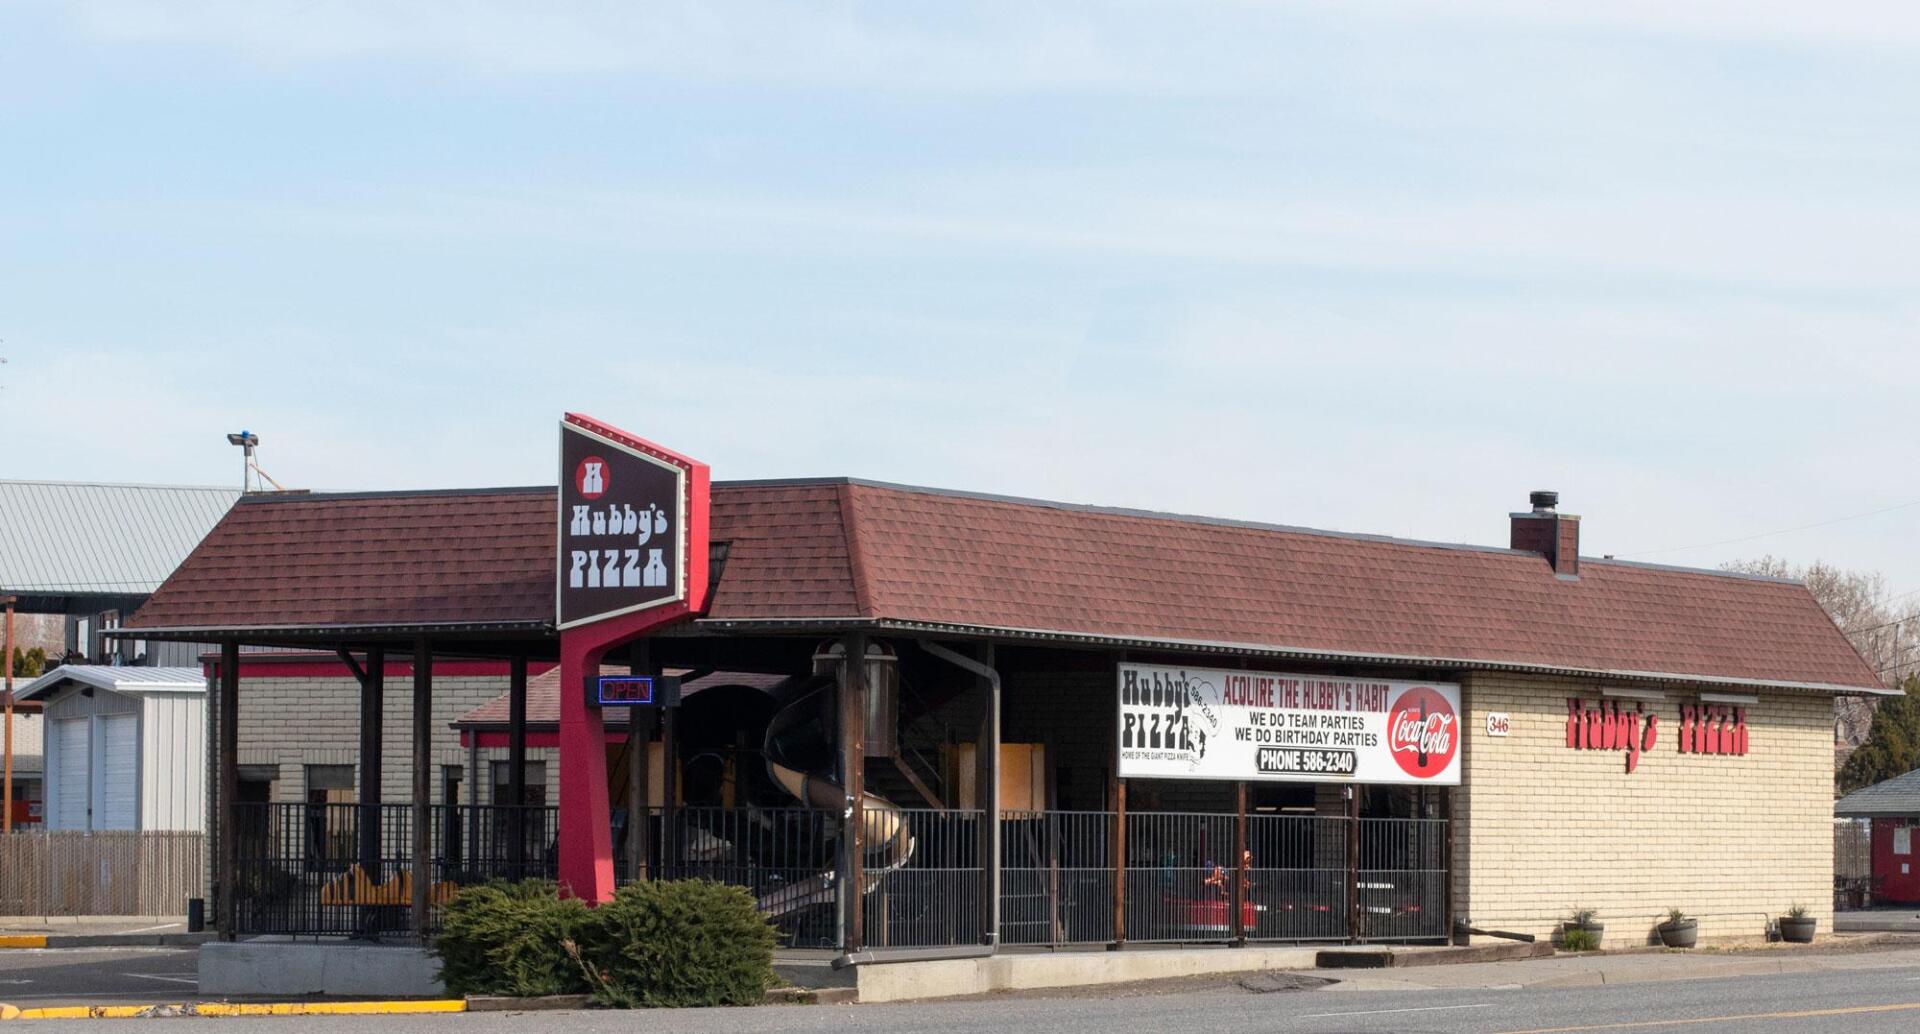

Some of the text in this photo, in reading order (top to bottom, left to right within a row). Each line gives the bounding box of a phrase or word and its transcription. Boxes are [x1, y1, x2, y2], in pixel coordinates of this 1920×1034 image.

[582, 462, 603, 493] H
[570, 503, 668, 546] Hubby's
[570, 548, 667, 588] PIZZA
[603, 681, 649, 699] OPEN
[1122, 670, 1191, 725] Hubby's
[1190, 686, 1218, 728] 586-2340
[1223, 675, 1389, 713] ACQUIRE THE HUBBY'S HABIT
[1122, 712, 1190, 750] PIZZA
[1235, 727, 1377, 747] WE DO BIRTHDAY PARTIES
[1250, 712, 1364, 730] WE DO TEAM PARTIES
[1391, 710, 1453, 754] Coca-Cola
[1489, 716, 1509, 733] 346
[1567, 698, 1658, 774] Hubby's
[1260, 750, 1353, 772] PHONE 586-2340
